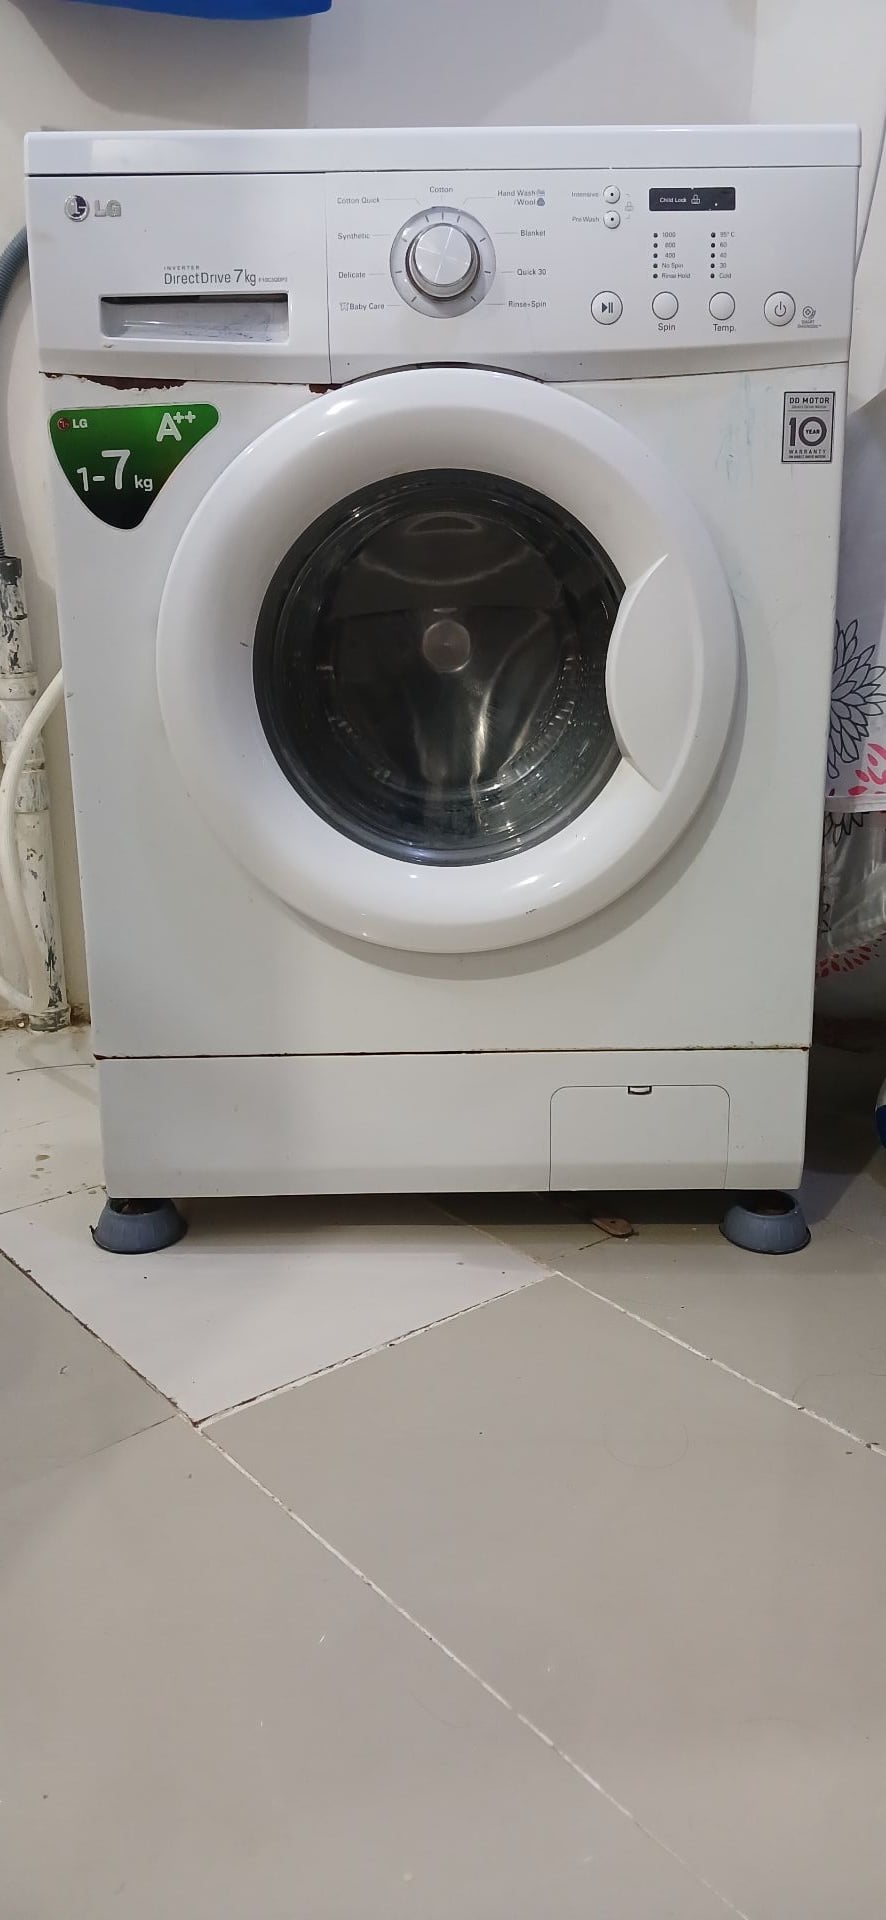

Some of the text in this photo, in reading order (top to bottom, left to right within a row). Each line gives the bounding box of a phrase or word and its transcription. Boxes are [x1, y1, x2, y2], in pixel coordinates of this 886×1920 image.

[516, 189, 536, 197] Wash
[336, 196, 380, 205] Cotton Quick
[94, 199, 122, 217] LG
[582, 215, 600, 223] Wash
[337, 232, 370, 241] Synthetic
[520, 229, 546, 237] Blanket
[671, 262, 684, 270] Spin
[338, 271, 366, 279] Delicate
[516, 268, 547, 276] Quick 30
[349, 302, 385, 311] Baby Care
[657, 322, 676, 333] Spin
[712, 323, 737, 333] Temp.
[789, 396, 830, 404] DD MOTOR
[72, 418, 88, 429] LG
[788, 416, 828, 447] 10
[134, 474, 154, 492] kg
